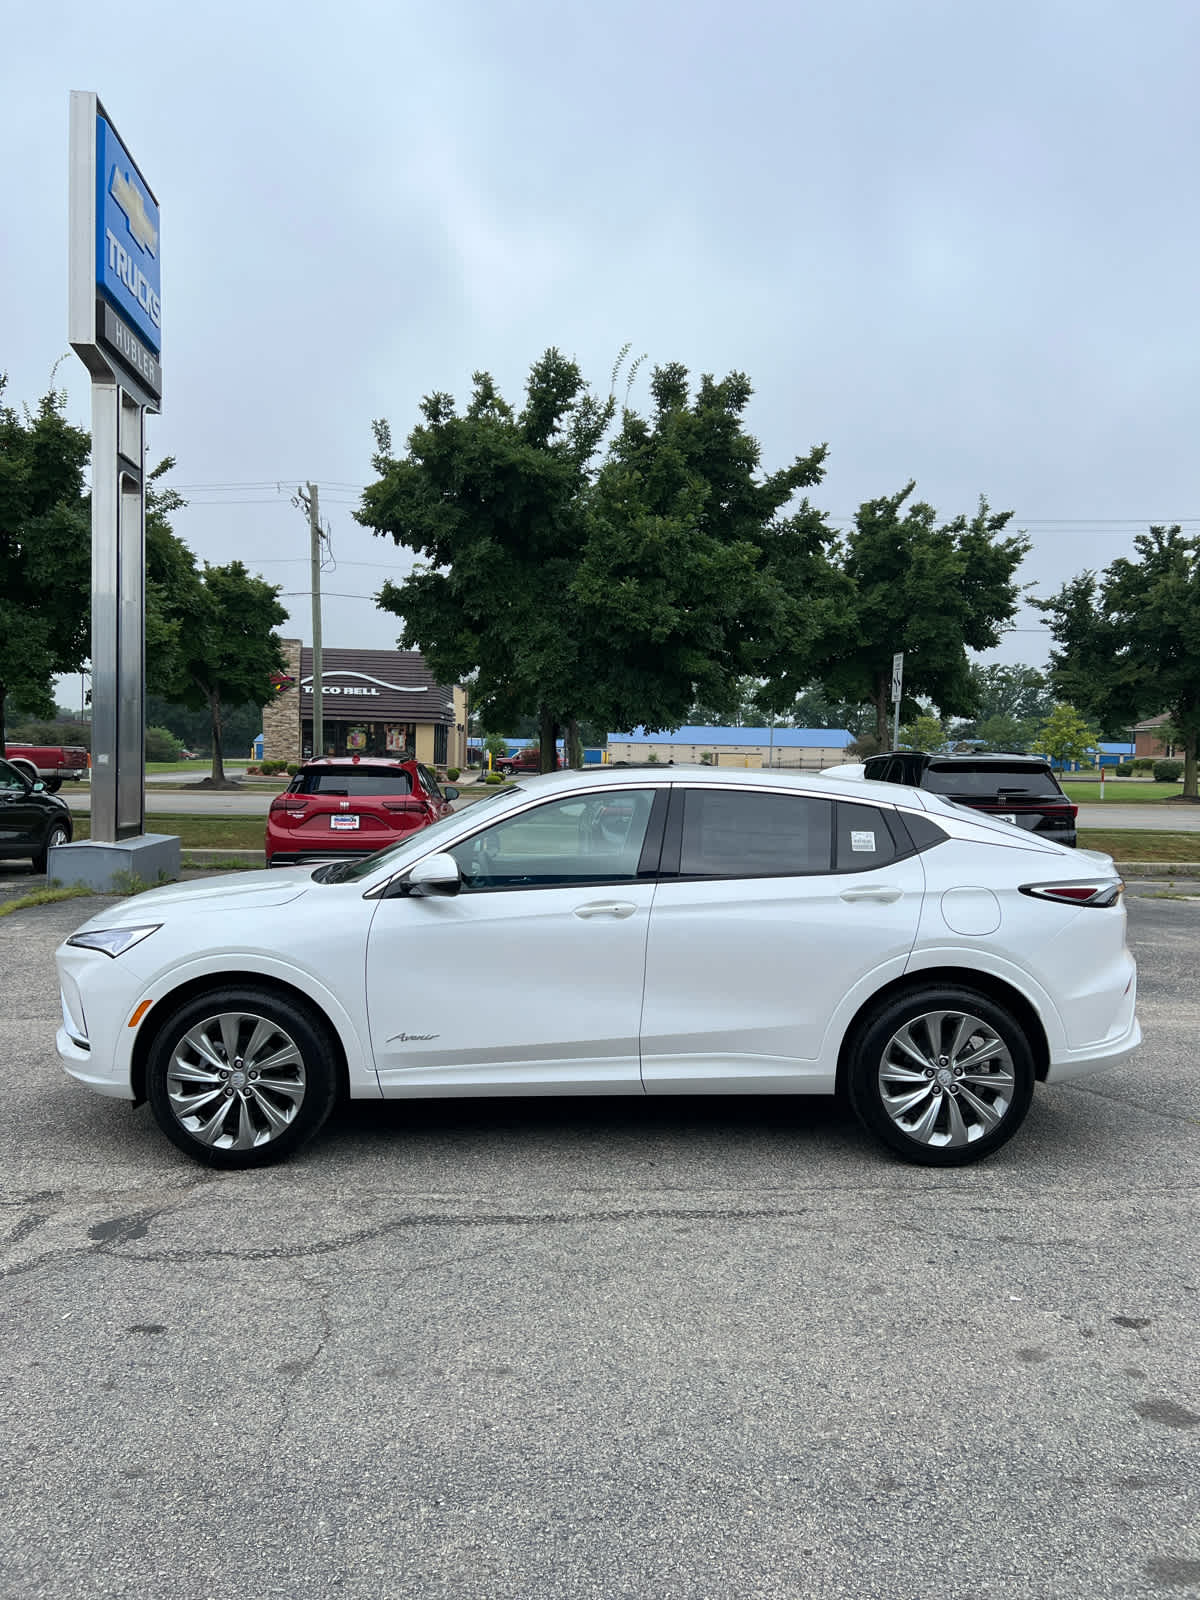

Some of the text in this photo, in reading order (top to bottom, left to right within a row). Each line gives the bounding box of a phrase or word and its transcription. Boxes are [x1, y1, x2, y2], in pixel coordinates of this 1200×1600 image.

[106, 228, 161, 328] TRUCKS
[115, 320, 156, 380] HUBLER
[302, 685, 380, 696] TCO BELL
